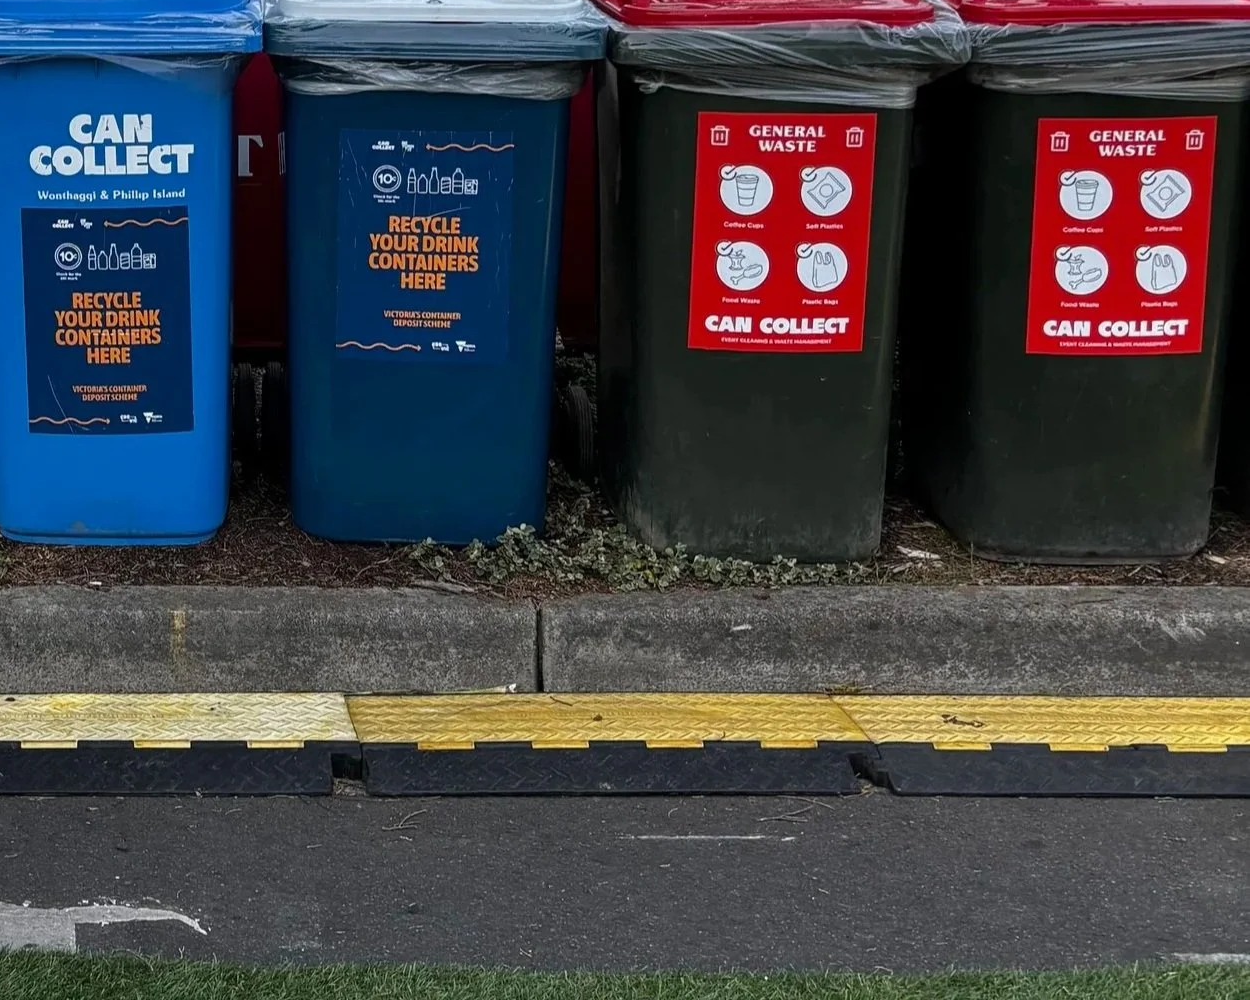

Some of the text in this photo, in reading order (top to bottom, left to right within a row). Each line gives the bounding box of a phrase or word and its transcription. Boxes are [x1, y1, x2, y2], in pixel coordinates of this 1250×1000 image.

[69, 113, 153, 144] CAN
[749, 125, 826, 138] GENERAL
[1089, 129, 1167, 142] GENERAL
[758, 140, 817, 153] WASTE
[1099, 144, 1157, 157] WASTE
[29, 144, 195, 176] COLLECT
[37, 188, 186, 202] Wonthaggi & Phillip Island
[388, 215, 461, 234] RECYCLE
[723, 221, 764, 230] Coffee Cups
[369, 233, 479, 253] YOUR DRINK
[368, 252, 479, 272] CONTAINERS
[401, 272, 446, 290] HERE
[72, 292, 141, 309] RECYCLE
[55, 309, 161, 327] YOUR DRINK
[383, 310, 461, 320] VICTORIA'S CONTAINER
[423, 320, 451, 328] SCHEME
[705, 315, 850, 335] CAN COLLECT
[1043, 319, 1189, 337] CAN COLLECT
[55, 328, 161, 346] CONTAINERS
[87, 347, 131, 364] HERE
[72, 385, 147, 393] VICTORIA'S CONTAINER
[82, 393, 138, 401] DEPOSIT SCHEME
